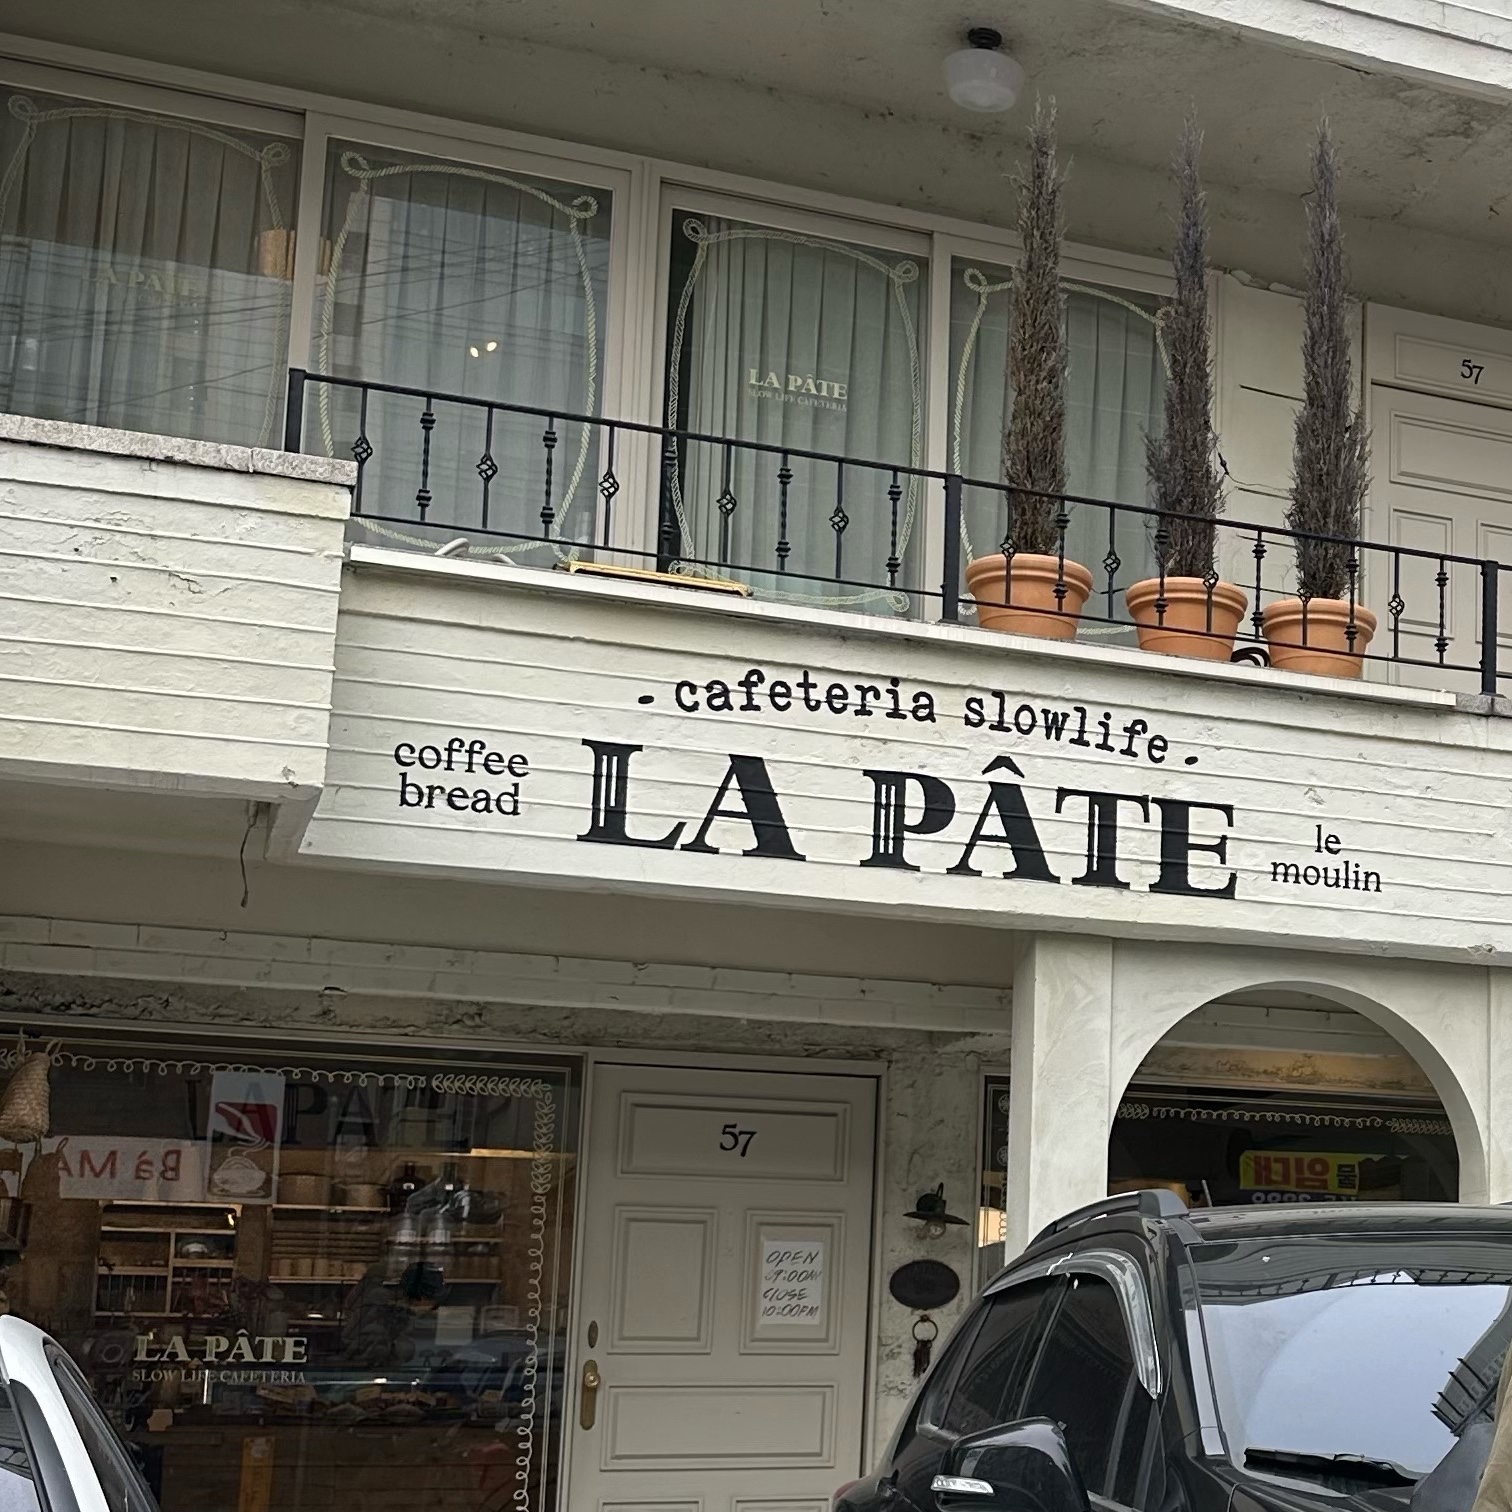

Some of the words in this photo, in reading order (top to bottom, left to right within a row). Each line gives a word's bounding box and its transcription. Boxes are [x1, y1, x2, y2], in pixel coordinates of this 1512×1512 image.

[749, 368, 782, 389] LA
[787, 373, 848, 400] PÂTE
[1460, 359, 1485, 385] 57
[674, 668, 937, 724] cafeteria
[964, 690, 1170, 765] slowlife
[394, 736, 530, 778] coffee
[398, 772, 522, 816] bread
[576, 738, 807, 862] LA
[859, 755, 1238, 900] PÂTE
[1314, 824, 1342, 856] le
[1270, 860, 1383, 894] moulin
[719, 1123, 758, 1158] 57
[766, 1250, 820, 1267] OPEN
[133, 1333, 192, 1363] LA
[202, 1328, 308, 1364] PÂTE
[132, 1368, 179, 1383] SLOW
[181, 1369, 217, 1383] LIFE
[219, 1369, 307, 1384] CAFETERIA
